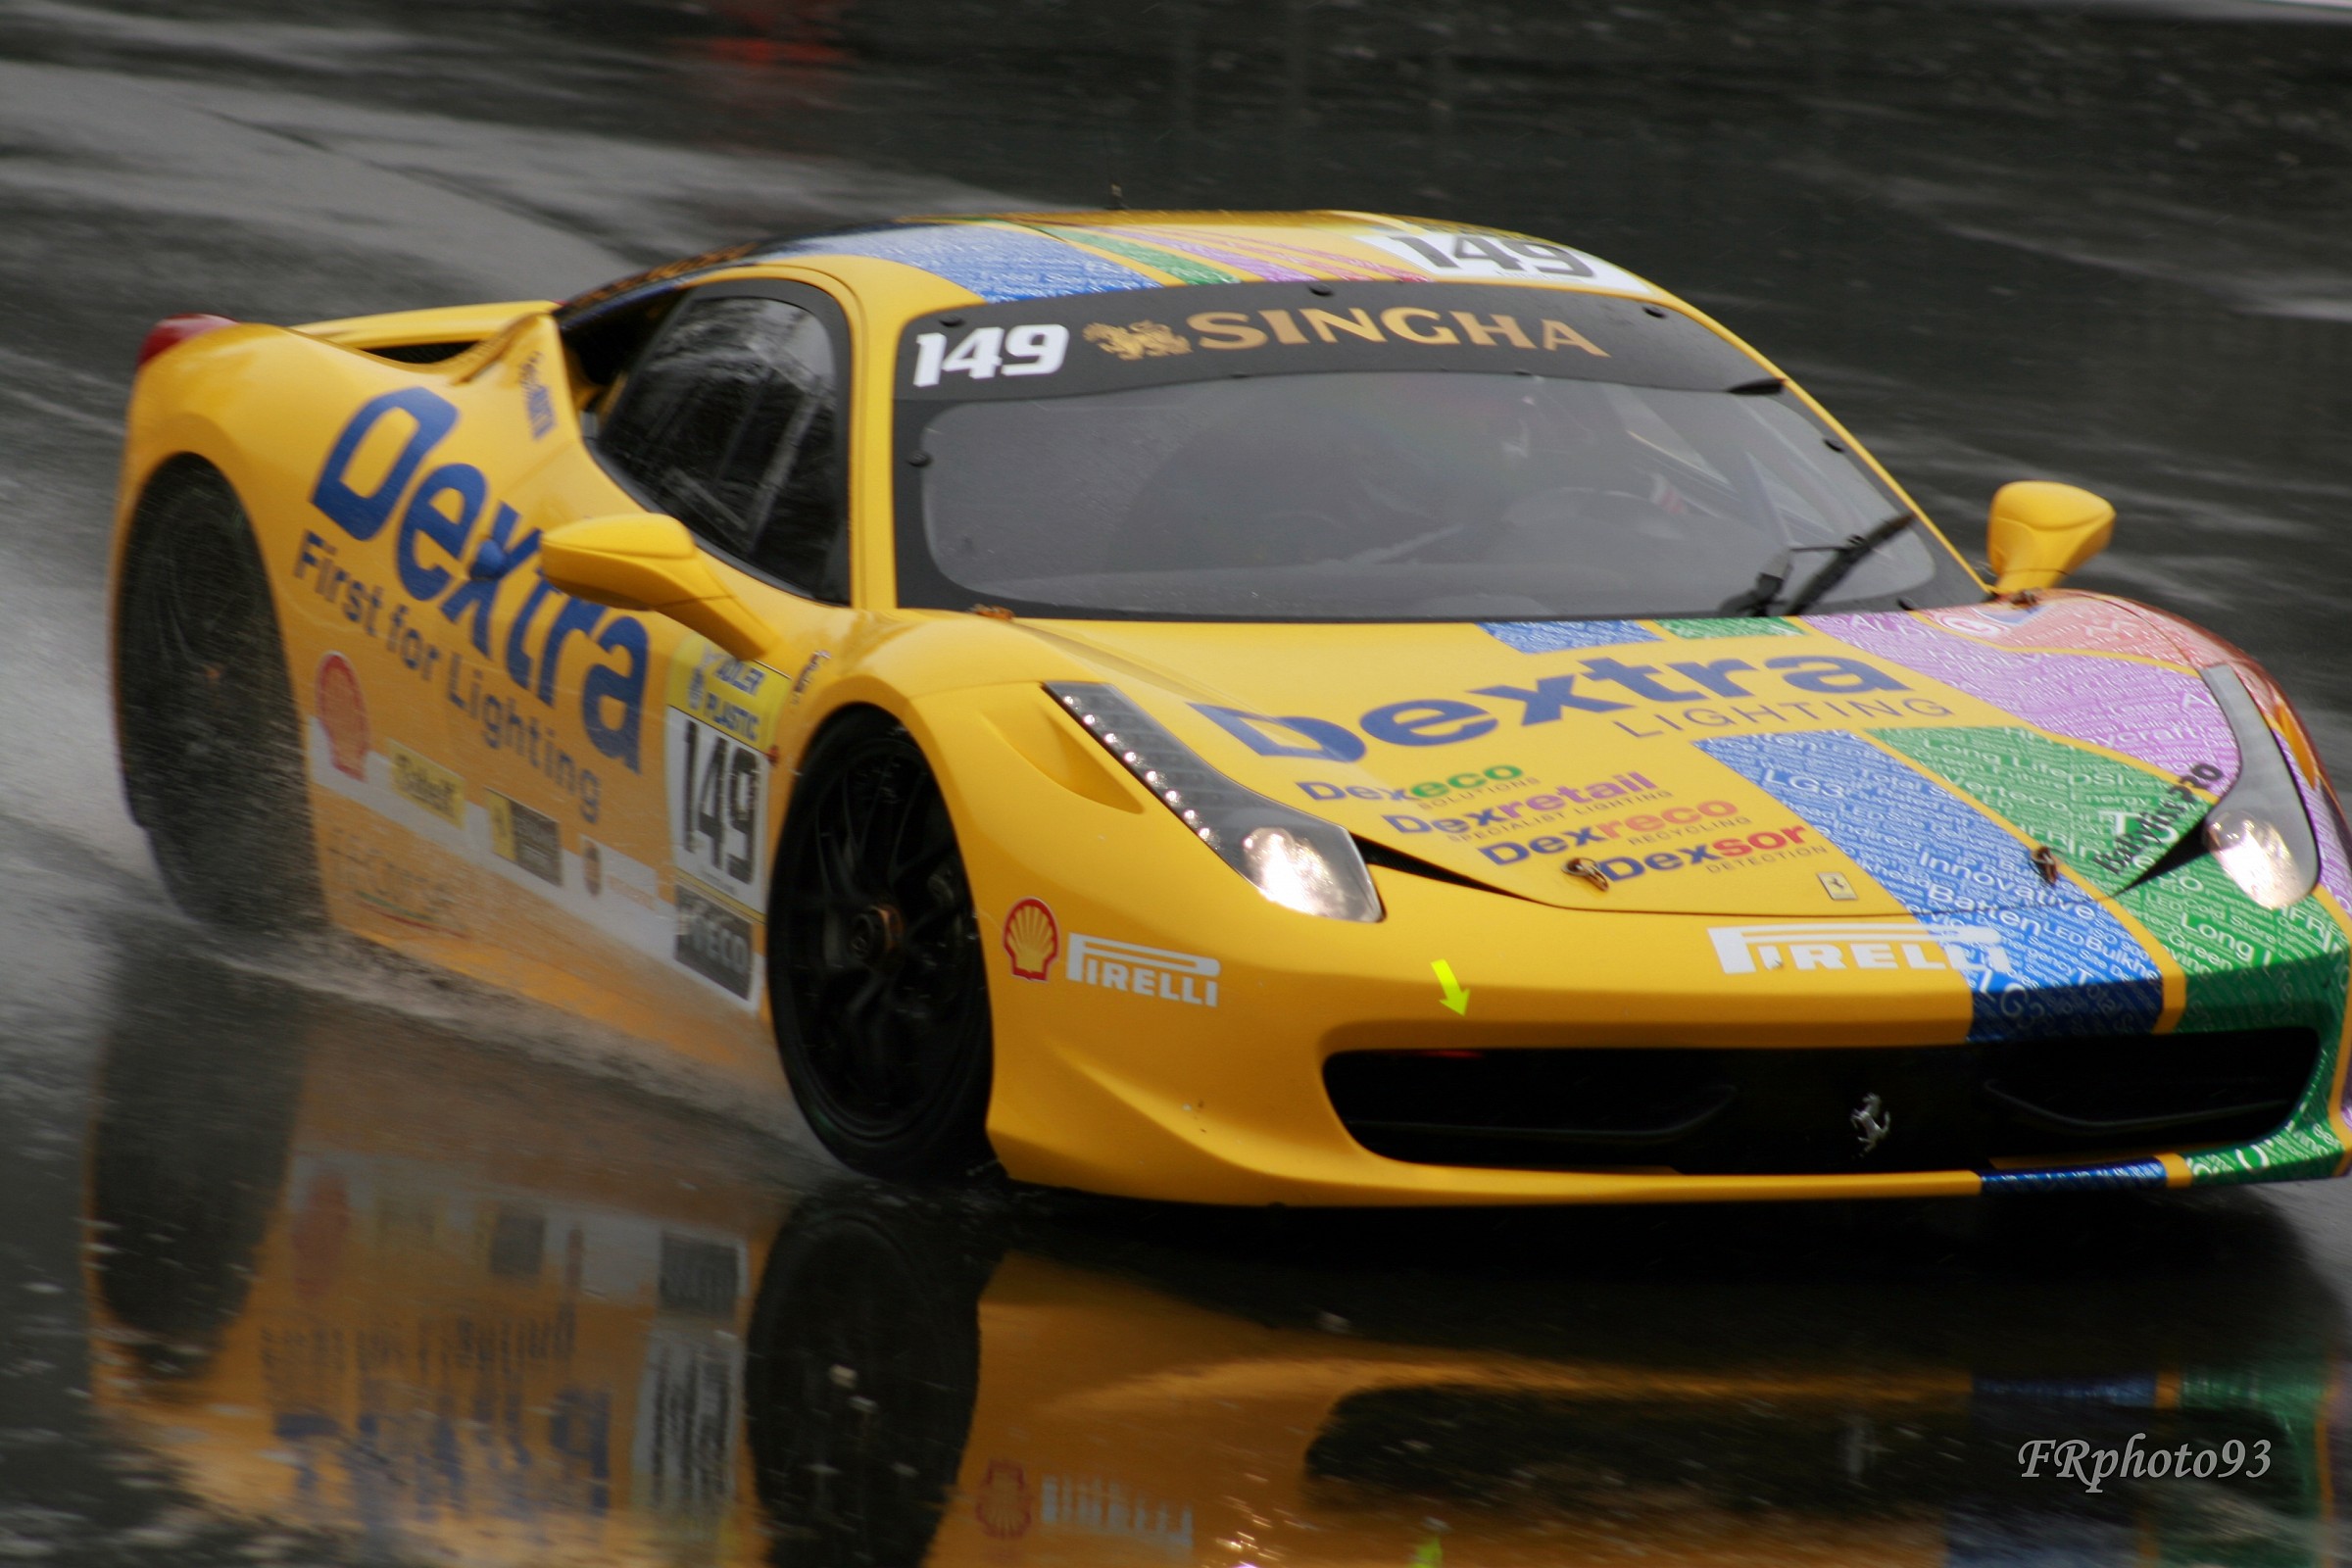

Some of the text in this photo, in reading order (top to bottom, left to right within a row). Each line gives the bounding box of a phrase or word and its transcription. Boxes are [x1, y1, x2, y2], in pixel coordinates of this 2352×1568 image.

[1386, 234, 1596, 278] 149
[912, 306, 1612, 388] 149 SINGHA
[309, 385, 651, 776] Dextra
[292, 529, 385, 639] First
[385, 605, 442, 682] for
[447, 655, 603, 825] Lighting
[1184, 653, 1915, 762] Dextra
[1612, 697, 1956, 737] LIGHTING
[681, 719, 760, 885] 149
[1295, 764, 1524, 802] Dexeco
[1380, 770, 1659, 834] Dexretail
[1418, 776, 1543, 811] SOLUTIONS
[1446, 790, 1675, 843] SPECIALIST LIGHTING
[1476, 799, 1739, 866] Dexreco
[1627, 814, 1753, 847] RECYCLING
[1599, 824, 1807, 882] Dexsor
[1704, 844, 1830, 875] DETECTION
[1918, 851, 2097, 921] Innovative
[1706, 922, 2012, 975] PIRELLI
[2180, 912, 2256, 966] Long
[1067, 931, 1222, 1008] PIRELLI
